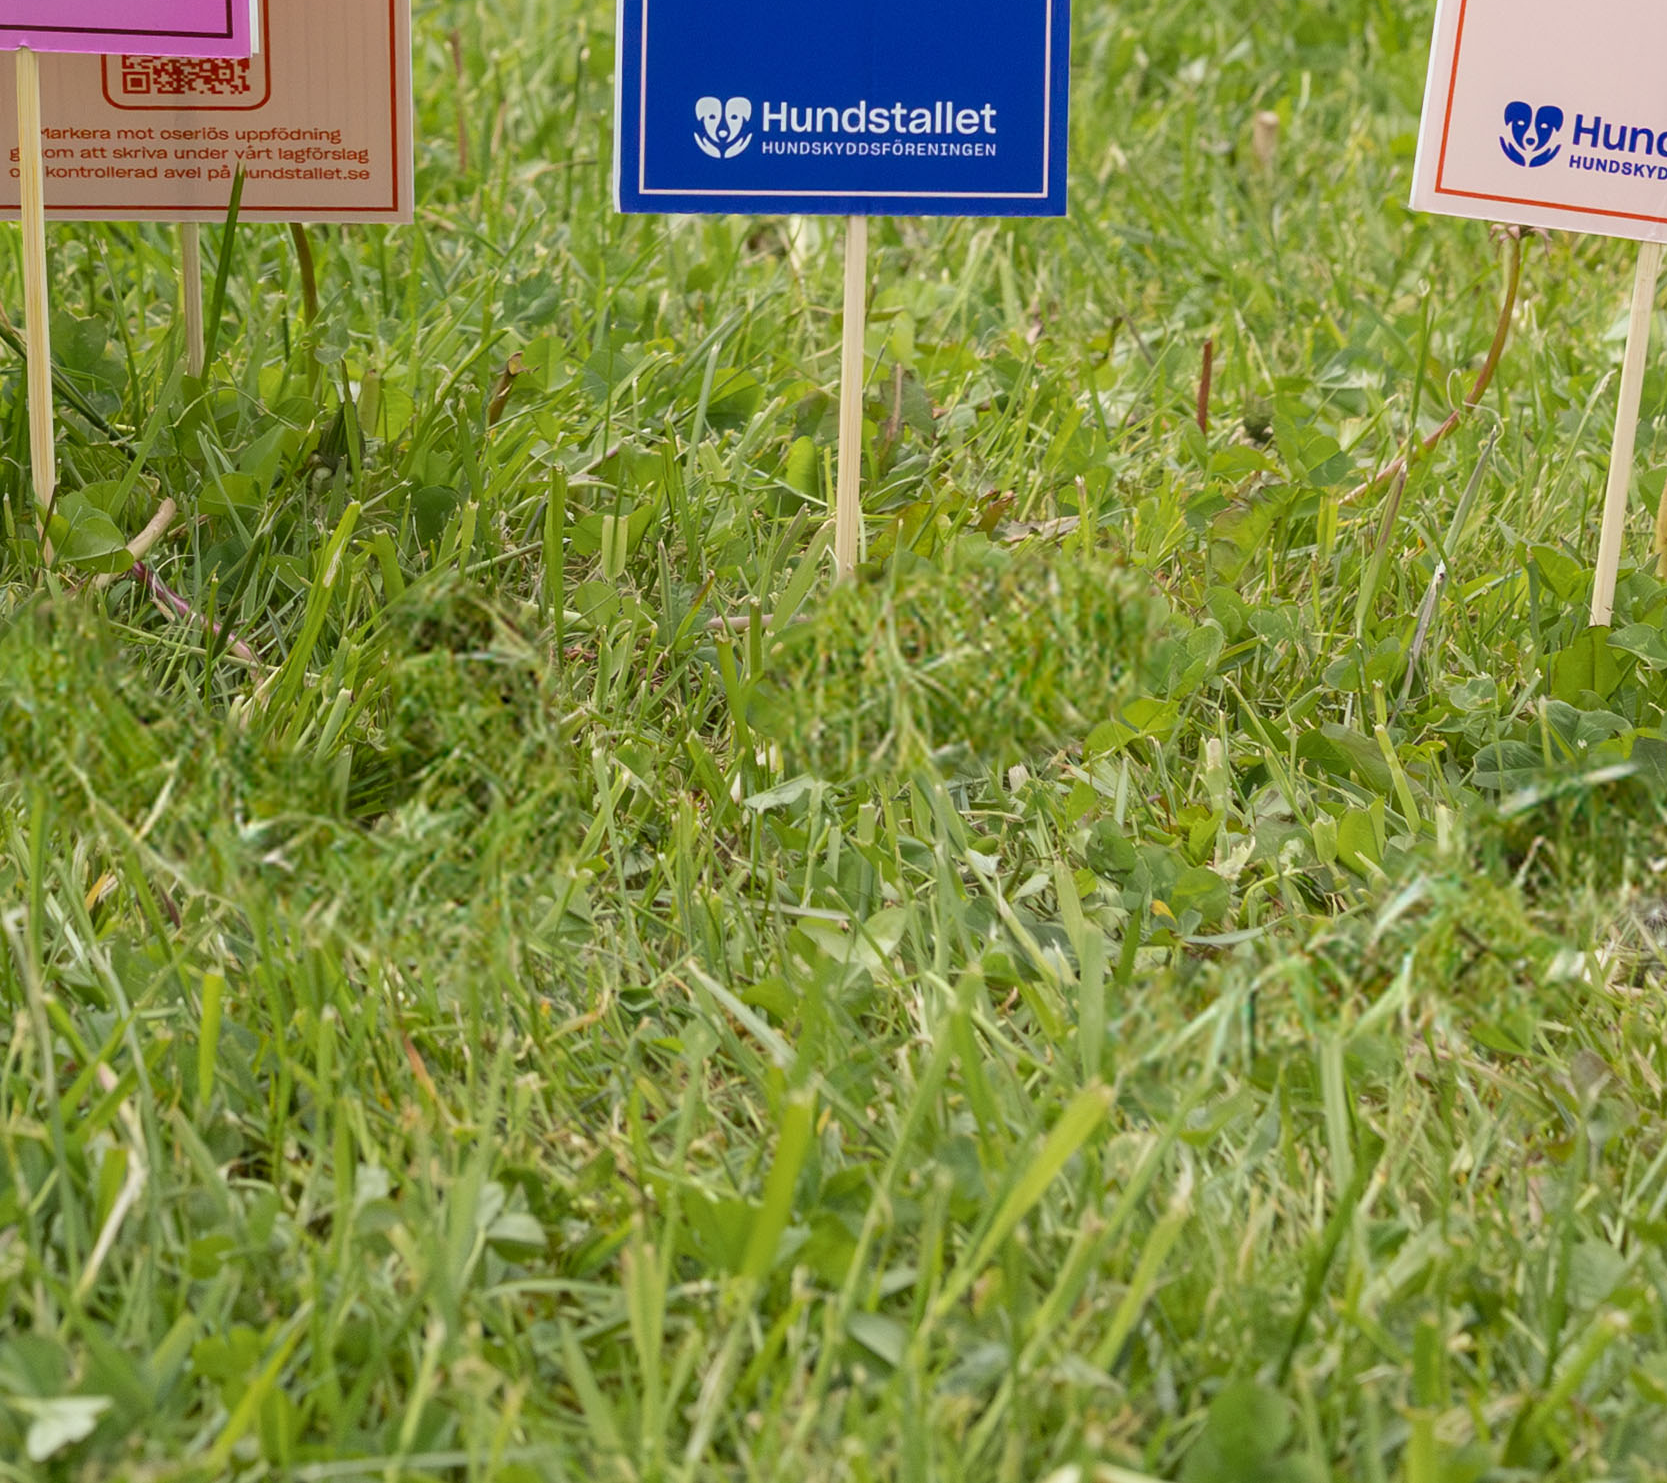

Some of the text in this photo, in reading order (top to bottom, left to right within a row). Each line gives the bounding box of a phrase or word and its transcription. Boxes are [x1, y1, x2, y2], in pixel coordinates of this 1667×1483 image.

[763, 101, 996, 134] Hundstallet
[117, 127, 155, 140] mot
[160, 127, 229, 141] oseriös
[235, 128, 342, 145] uppfödning
[9, 145, 369, 164] gom att skriva under vårt lagförslag
[762, 139, 996, 156] HUNDSKYDDSFÖRENINGEN
[46, 166, 158, 178] kontrollerad
[164, 167, 201, 179] avel
[208, 164, 231, 182] på
